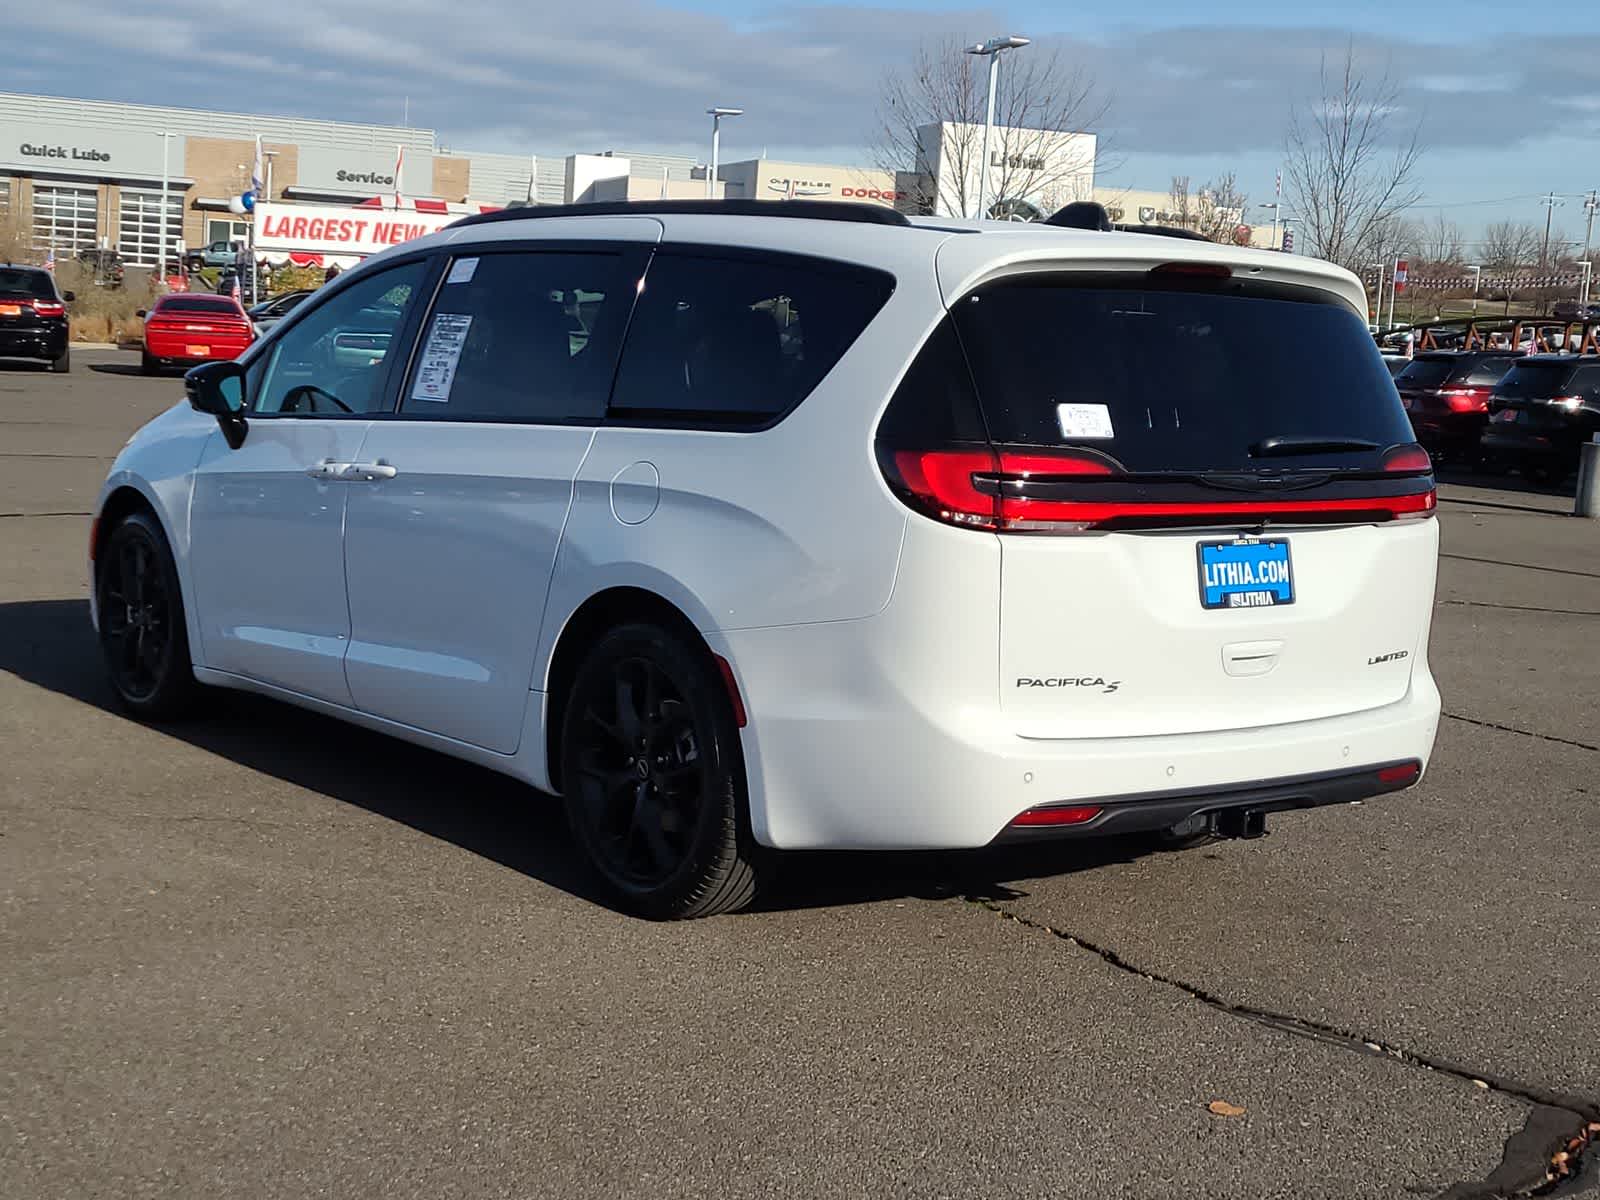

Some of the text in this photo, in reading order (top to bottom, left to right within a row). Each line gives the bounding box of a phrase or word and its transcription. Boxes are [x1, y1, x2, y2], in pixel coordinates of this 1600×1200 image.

[20, 143, 111, 162] Quick Lube
[335, 169, 394, 185] Service
[262, 215, 427, 245] LARGEST NEW
[1204, 559, 1290, 587] LITHIA.COM
[1239, 591, 1274, 606] LITHIA
[1367, 650, 1409, 665] LIMITED
[1016, 677, 1105, 688] PACIFICA
